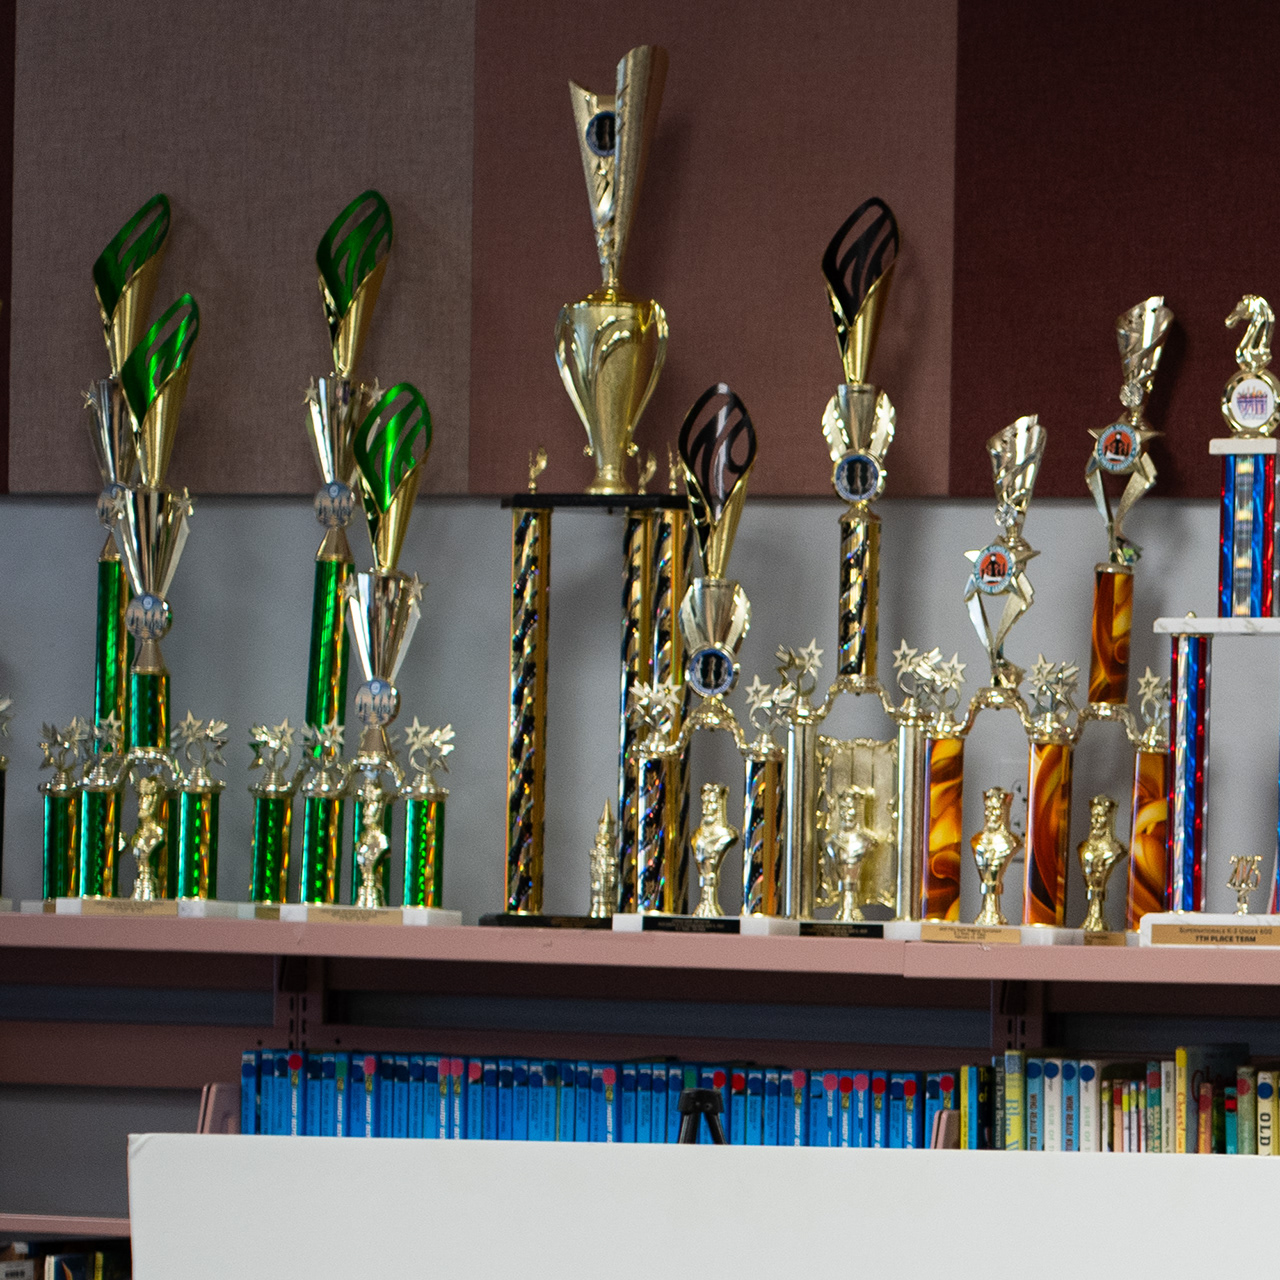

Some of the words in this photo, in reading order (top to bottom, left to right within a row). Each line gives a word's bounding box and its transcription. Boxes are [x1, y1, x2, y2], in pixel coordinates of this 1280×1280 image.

[995, 1085, 1005, 1108] Door
[1005, 1099, 1020, 1136] Blue
[1260, 1113, 1271, 1146] OLD
